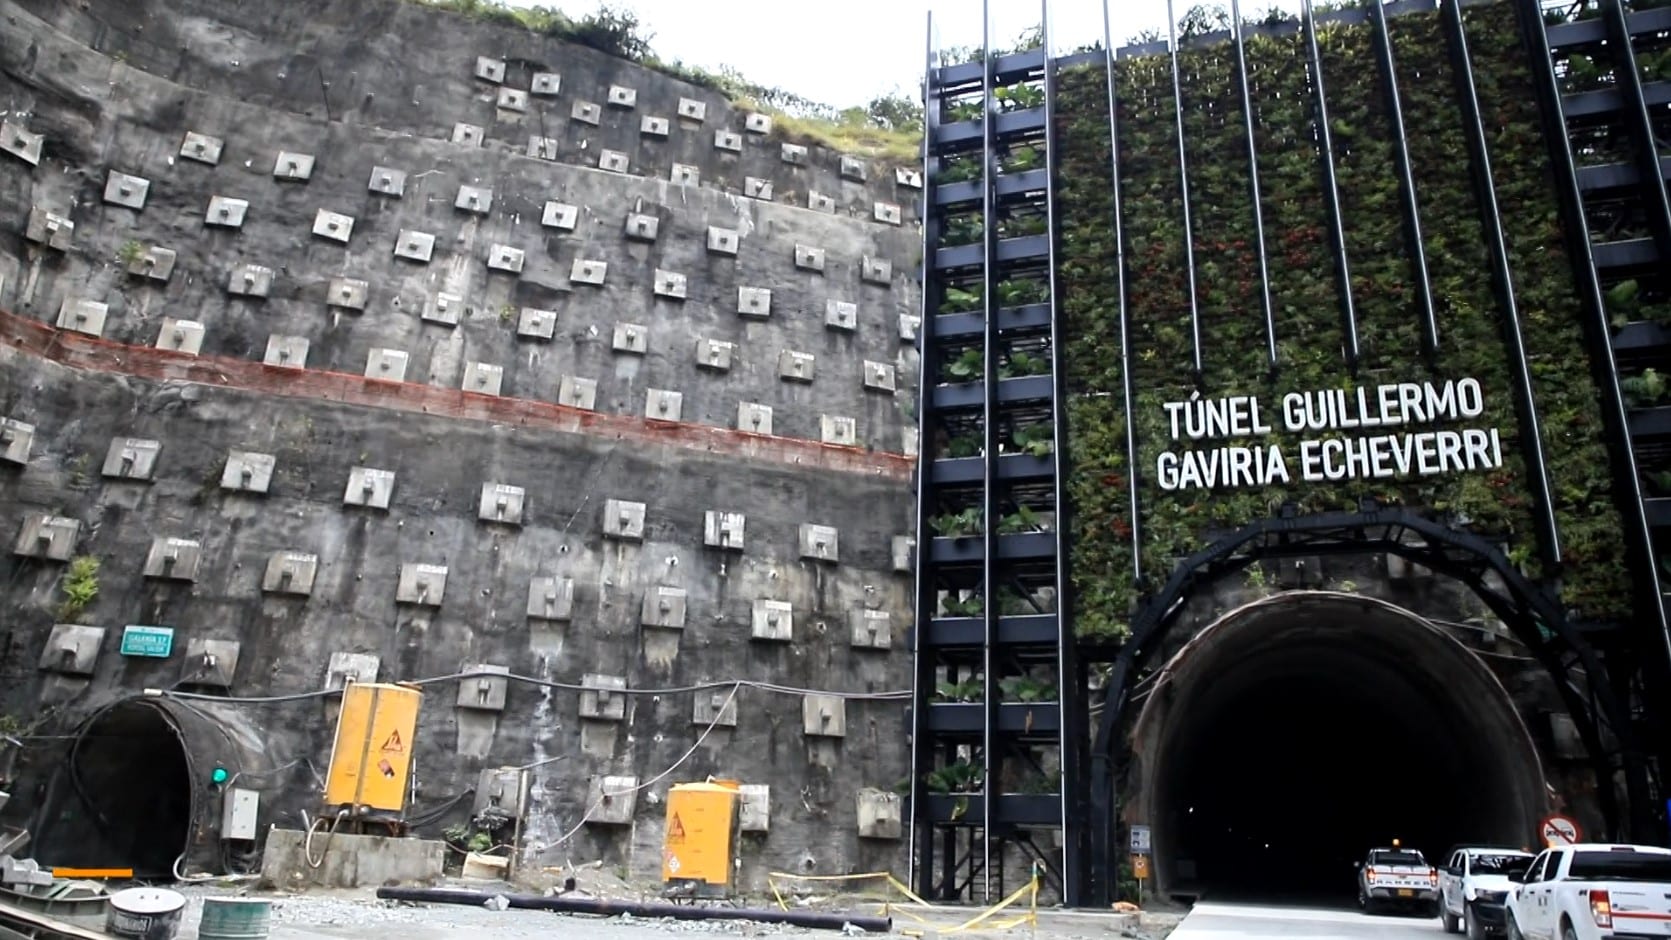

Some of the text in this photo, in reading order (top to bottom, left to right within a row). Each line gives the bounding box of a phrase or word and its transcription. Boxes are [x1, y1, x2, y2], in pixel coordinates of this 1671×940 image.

[1163, 377, 1483, 440] TÚNEL GUILLERMO
[1157, 428, 1503, 490] GAVIRIA ECHEVERRI
